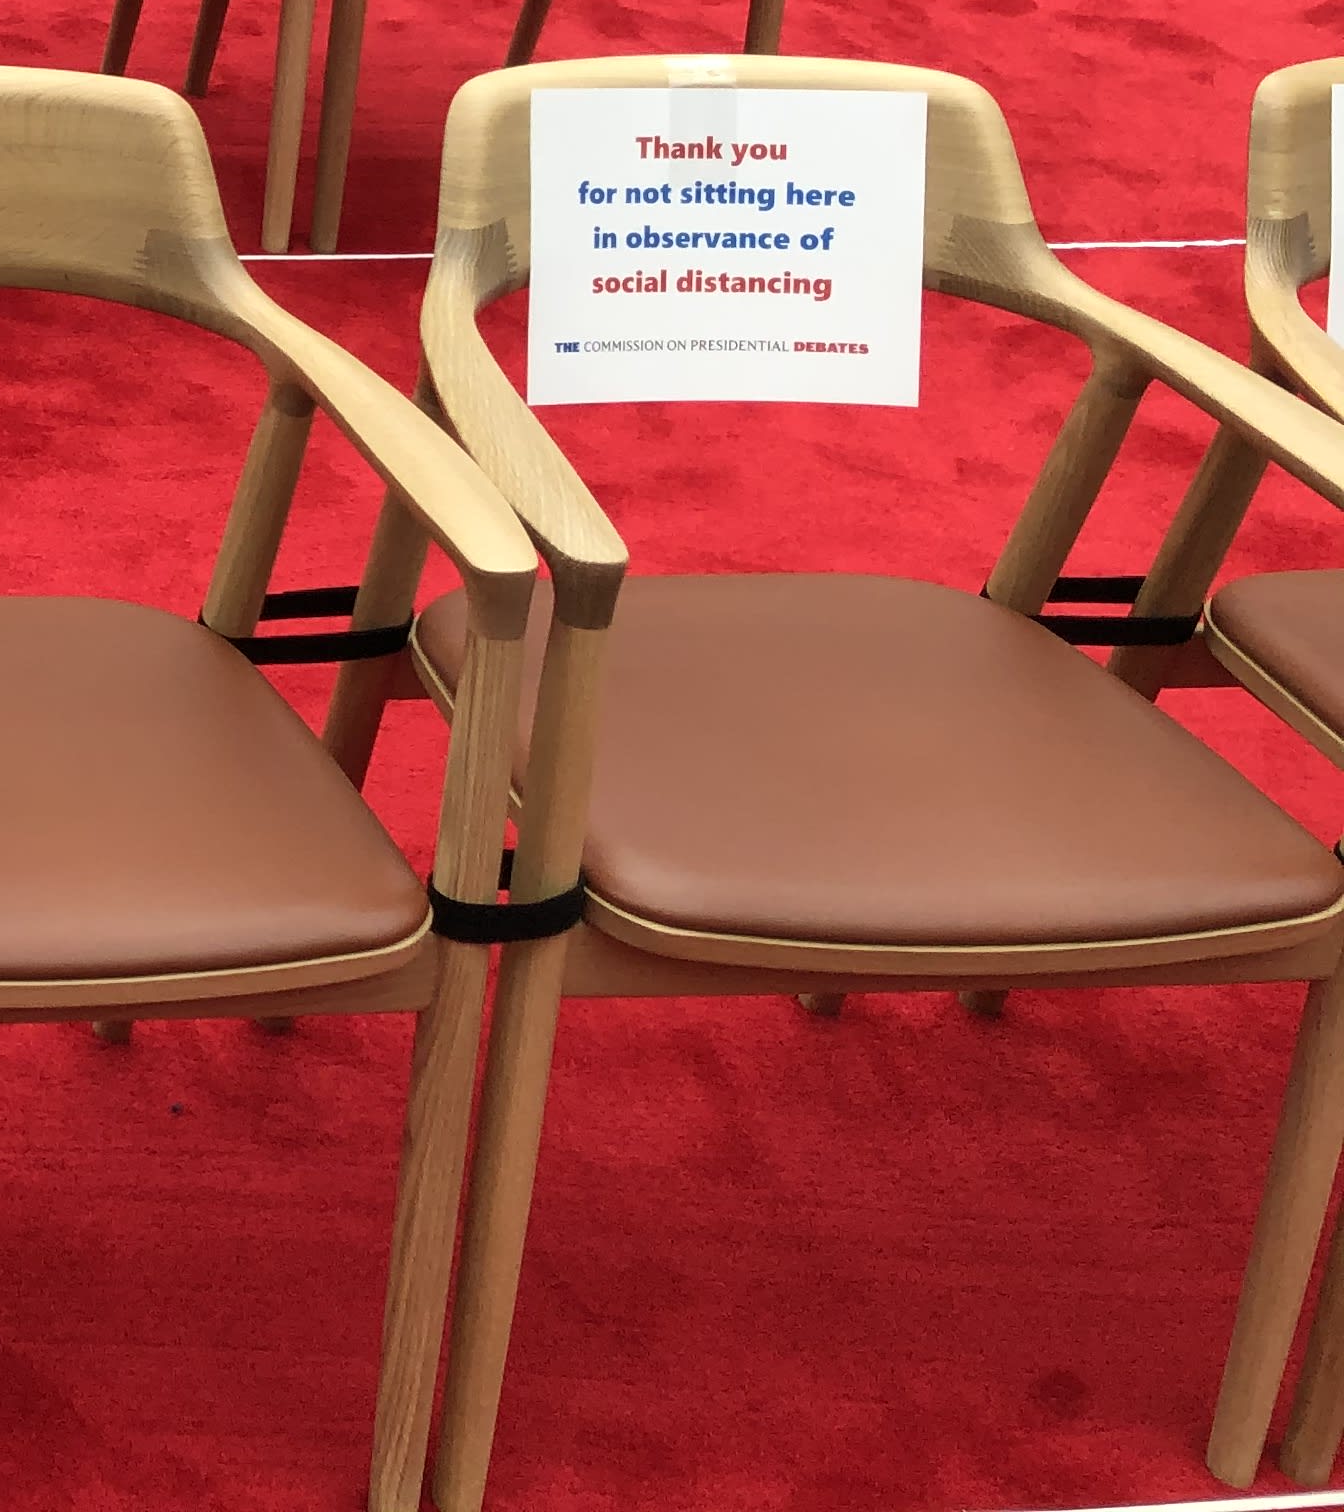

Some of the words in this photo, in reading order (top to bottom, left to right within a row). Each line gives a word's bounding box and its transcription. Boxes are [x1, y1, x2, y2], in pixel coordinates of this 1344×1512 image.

[636, 136, 723, 160] Thank
[731, 144, 787, 166] you
[578, 180, 617, 204] for
[625, 183, 672, 204] not
[680, 181, 775, 212] sitting
[786, 182, 855, 206] here
[594, 226, 617, 249] in
[626, 225, 790, 250] observance
[800, 227, 834, 250] of
[592, 269, 667, 294] social
[676, 269, 832, 302] distancing
[554, 342, 580, 353] THE
[584, 340, 663, 352] COMMISSION
[667, 340, 686, 351] ON
[691, 340, 788, 352] PRESIDENTIAL
[794, 342, 869, 354] DEBATES
